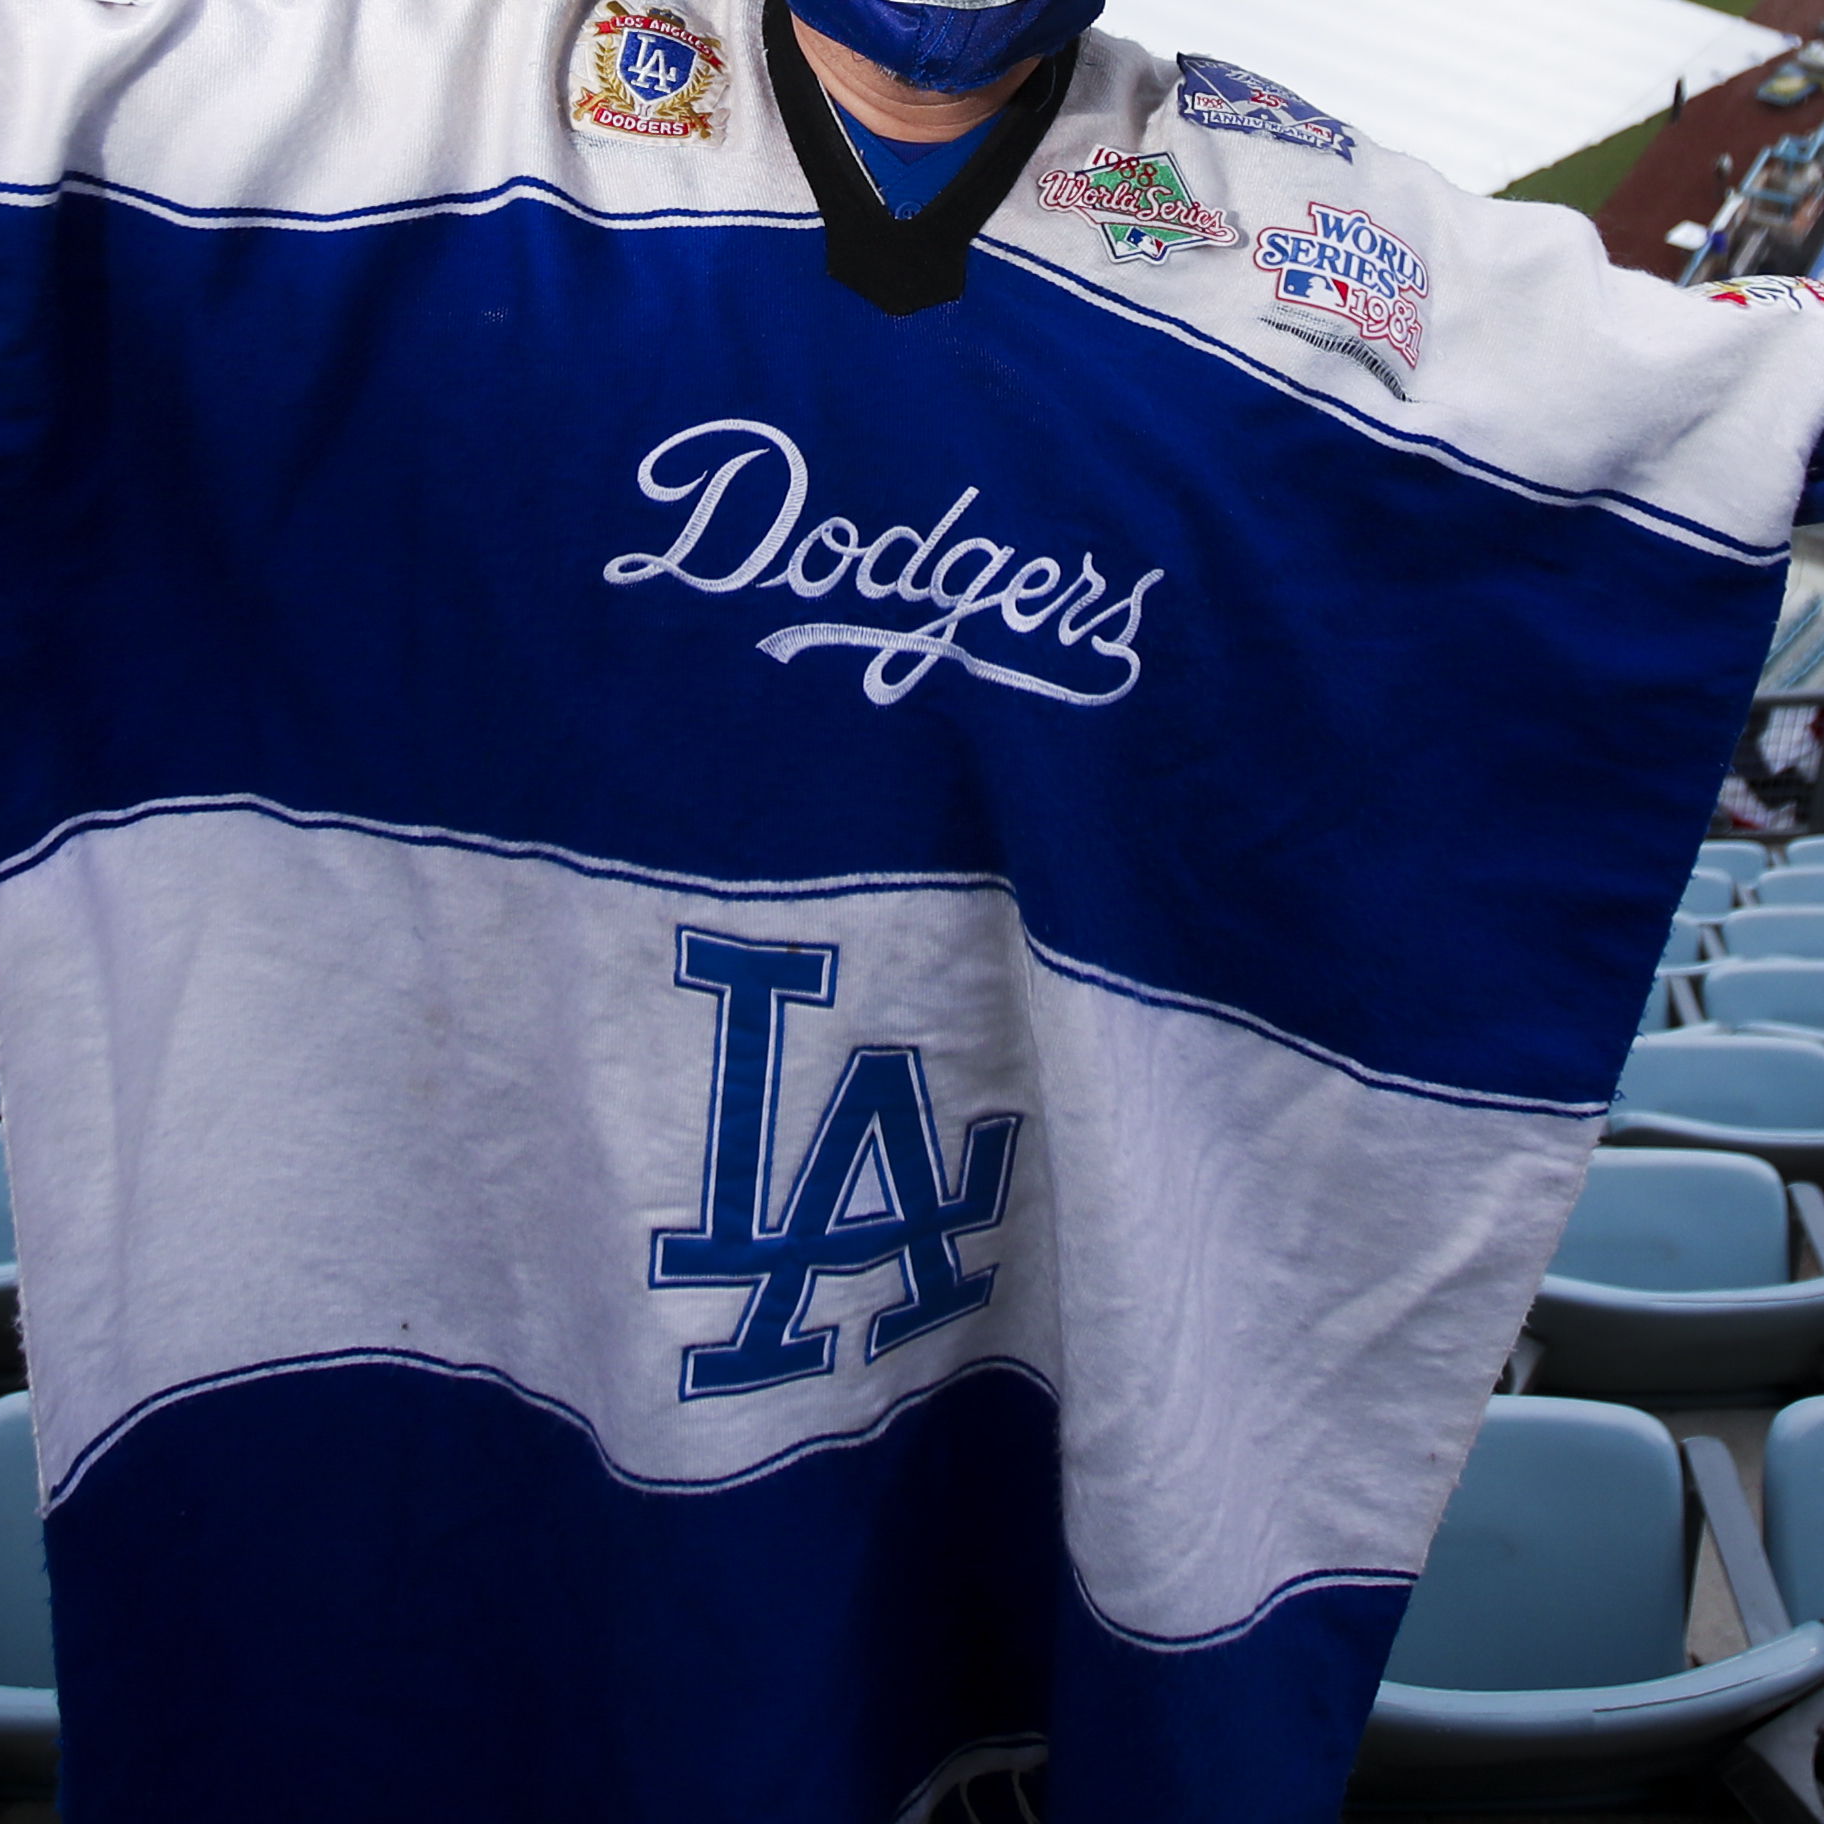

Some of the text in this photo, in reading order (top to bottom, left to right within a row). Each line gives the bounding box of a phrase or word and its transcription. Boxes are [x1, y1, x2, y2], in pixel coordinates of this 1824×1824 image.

[615, 16, 711, 55] LOS ANGELES
[627, 33, 677, 94] LA
[599, 109, 685, 136] DODGERS
[1196, 95, 1224, 110] 1958
[1092, 147, 1158, 187] 1988
[1040, 169, 1228, 235] World Series
[1262, 233, 1396, 300] SERIES
[1315, 210, 1425, 291] WORLD
[1350, 288, 1423, 368] 1981
[603, 418, 1166, 706] Dodgers
[648, 924, 1024, 1403] LA
